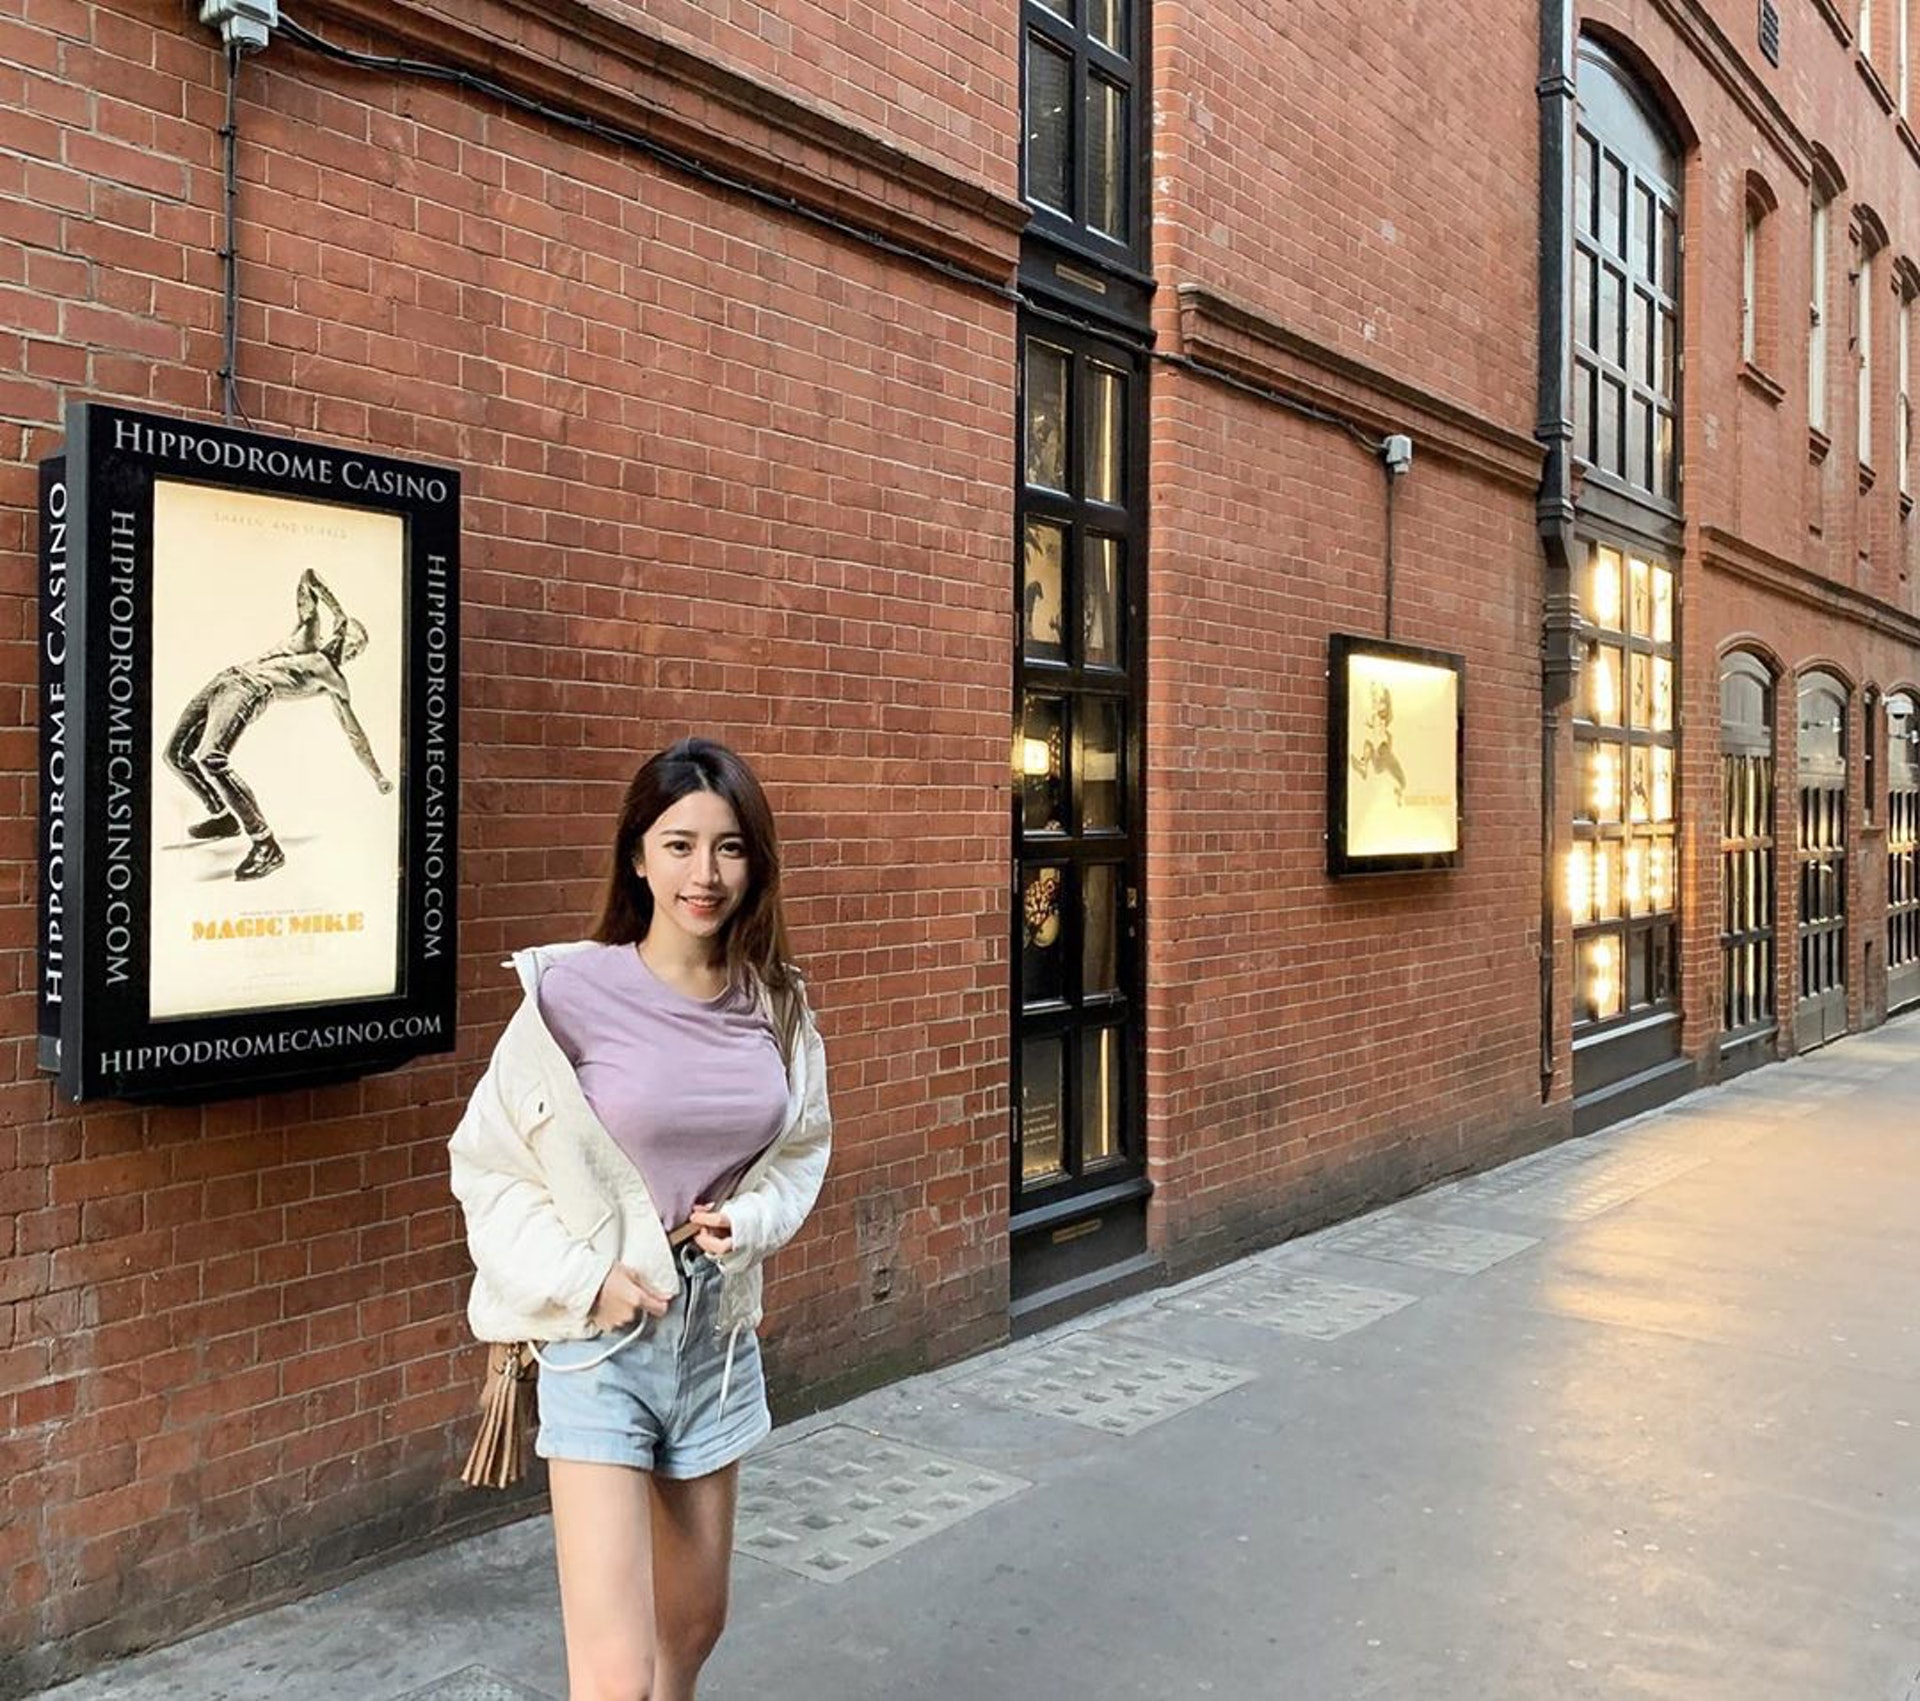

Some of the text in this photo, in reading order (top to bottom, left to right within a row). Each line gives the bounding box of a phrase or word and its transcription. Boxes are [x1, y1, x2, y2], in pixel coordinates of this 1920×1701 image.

[113, 418, 448, 503] HIPPODROME CASINO
[47, 482, 68, 666] CASINO
[105, 510, 136, 986] HIPPODROMECASINO.COM
[423, 554, 447, 960] HIPPODROMECASINO.COM
[192, 911, 365, 942] MAGIC MIKE
[100, 1013, 443, 1076] HIPPODROMECASINO.COM
